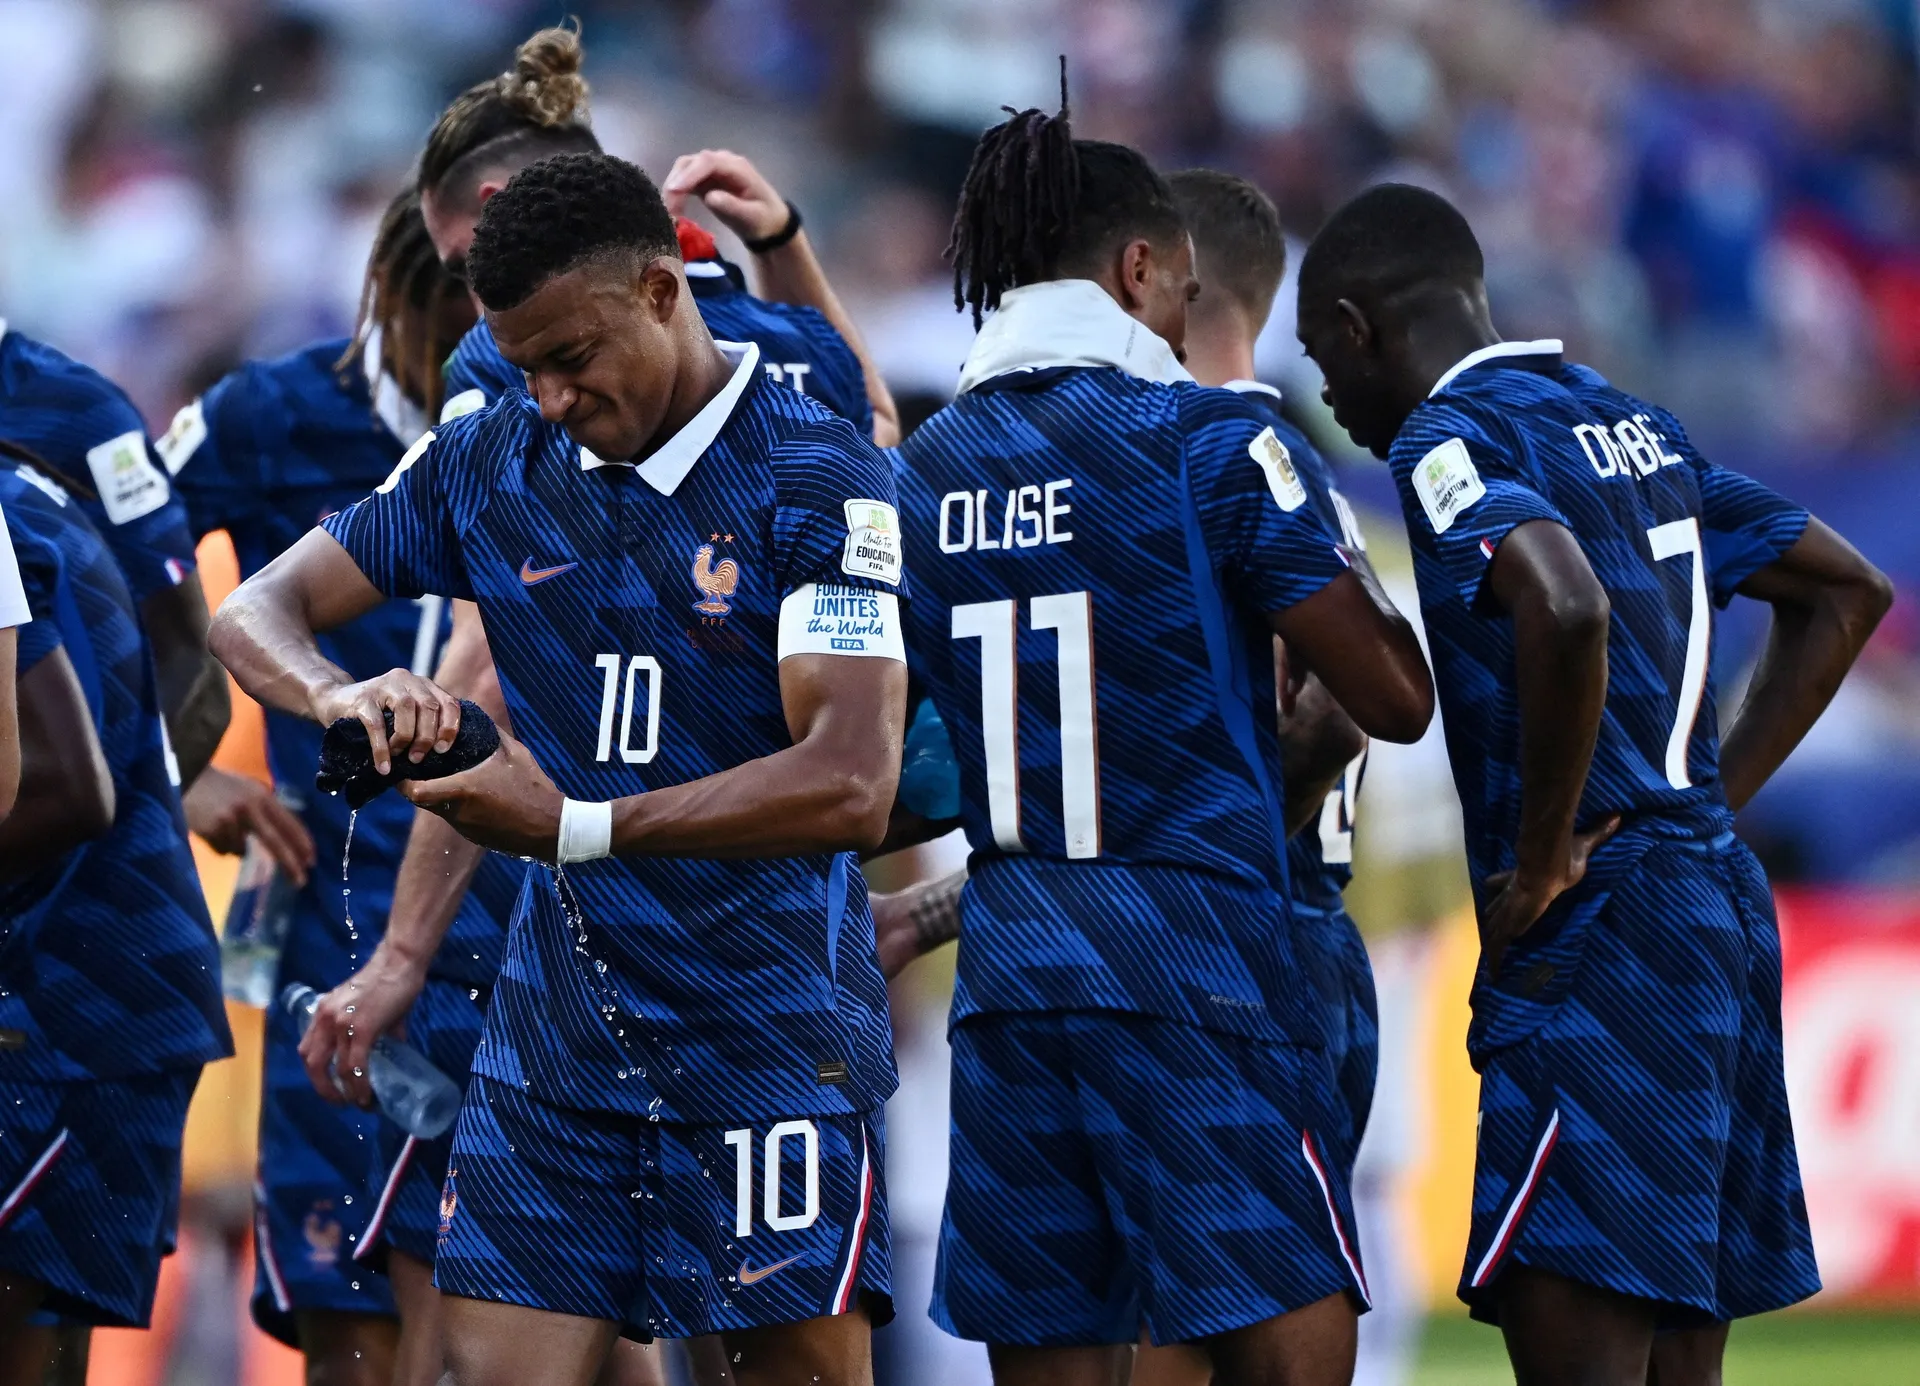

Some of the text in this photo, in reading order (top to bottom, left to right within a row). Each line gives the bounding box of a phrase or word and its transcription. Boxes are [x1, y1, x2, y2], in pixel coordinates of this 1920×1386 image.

[1435, 478, 1469, 515] EDUCATION
[938, 478, 1074, 554] OLISE
[862, 531, 893, 549] Unite For
[856, 545, 896, 566] EDUCATION
[868, 562, 884, 571] FIFA
[815, 583, 878, 599] FOOTBALL
[813, 597, 880, 618] UNITES
[806, 618, 884, 638] the World
[832, 640, 864, 650] FIFA
[1646, 516, 1710, 790] 7
[595, 653, 662, 764] 10
[951, 590, 1100, 860] 11
[724, 1119, 820, 1238] 10
